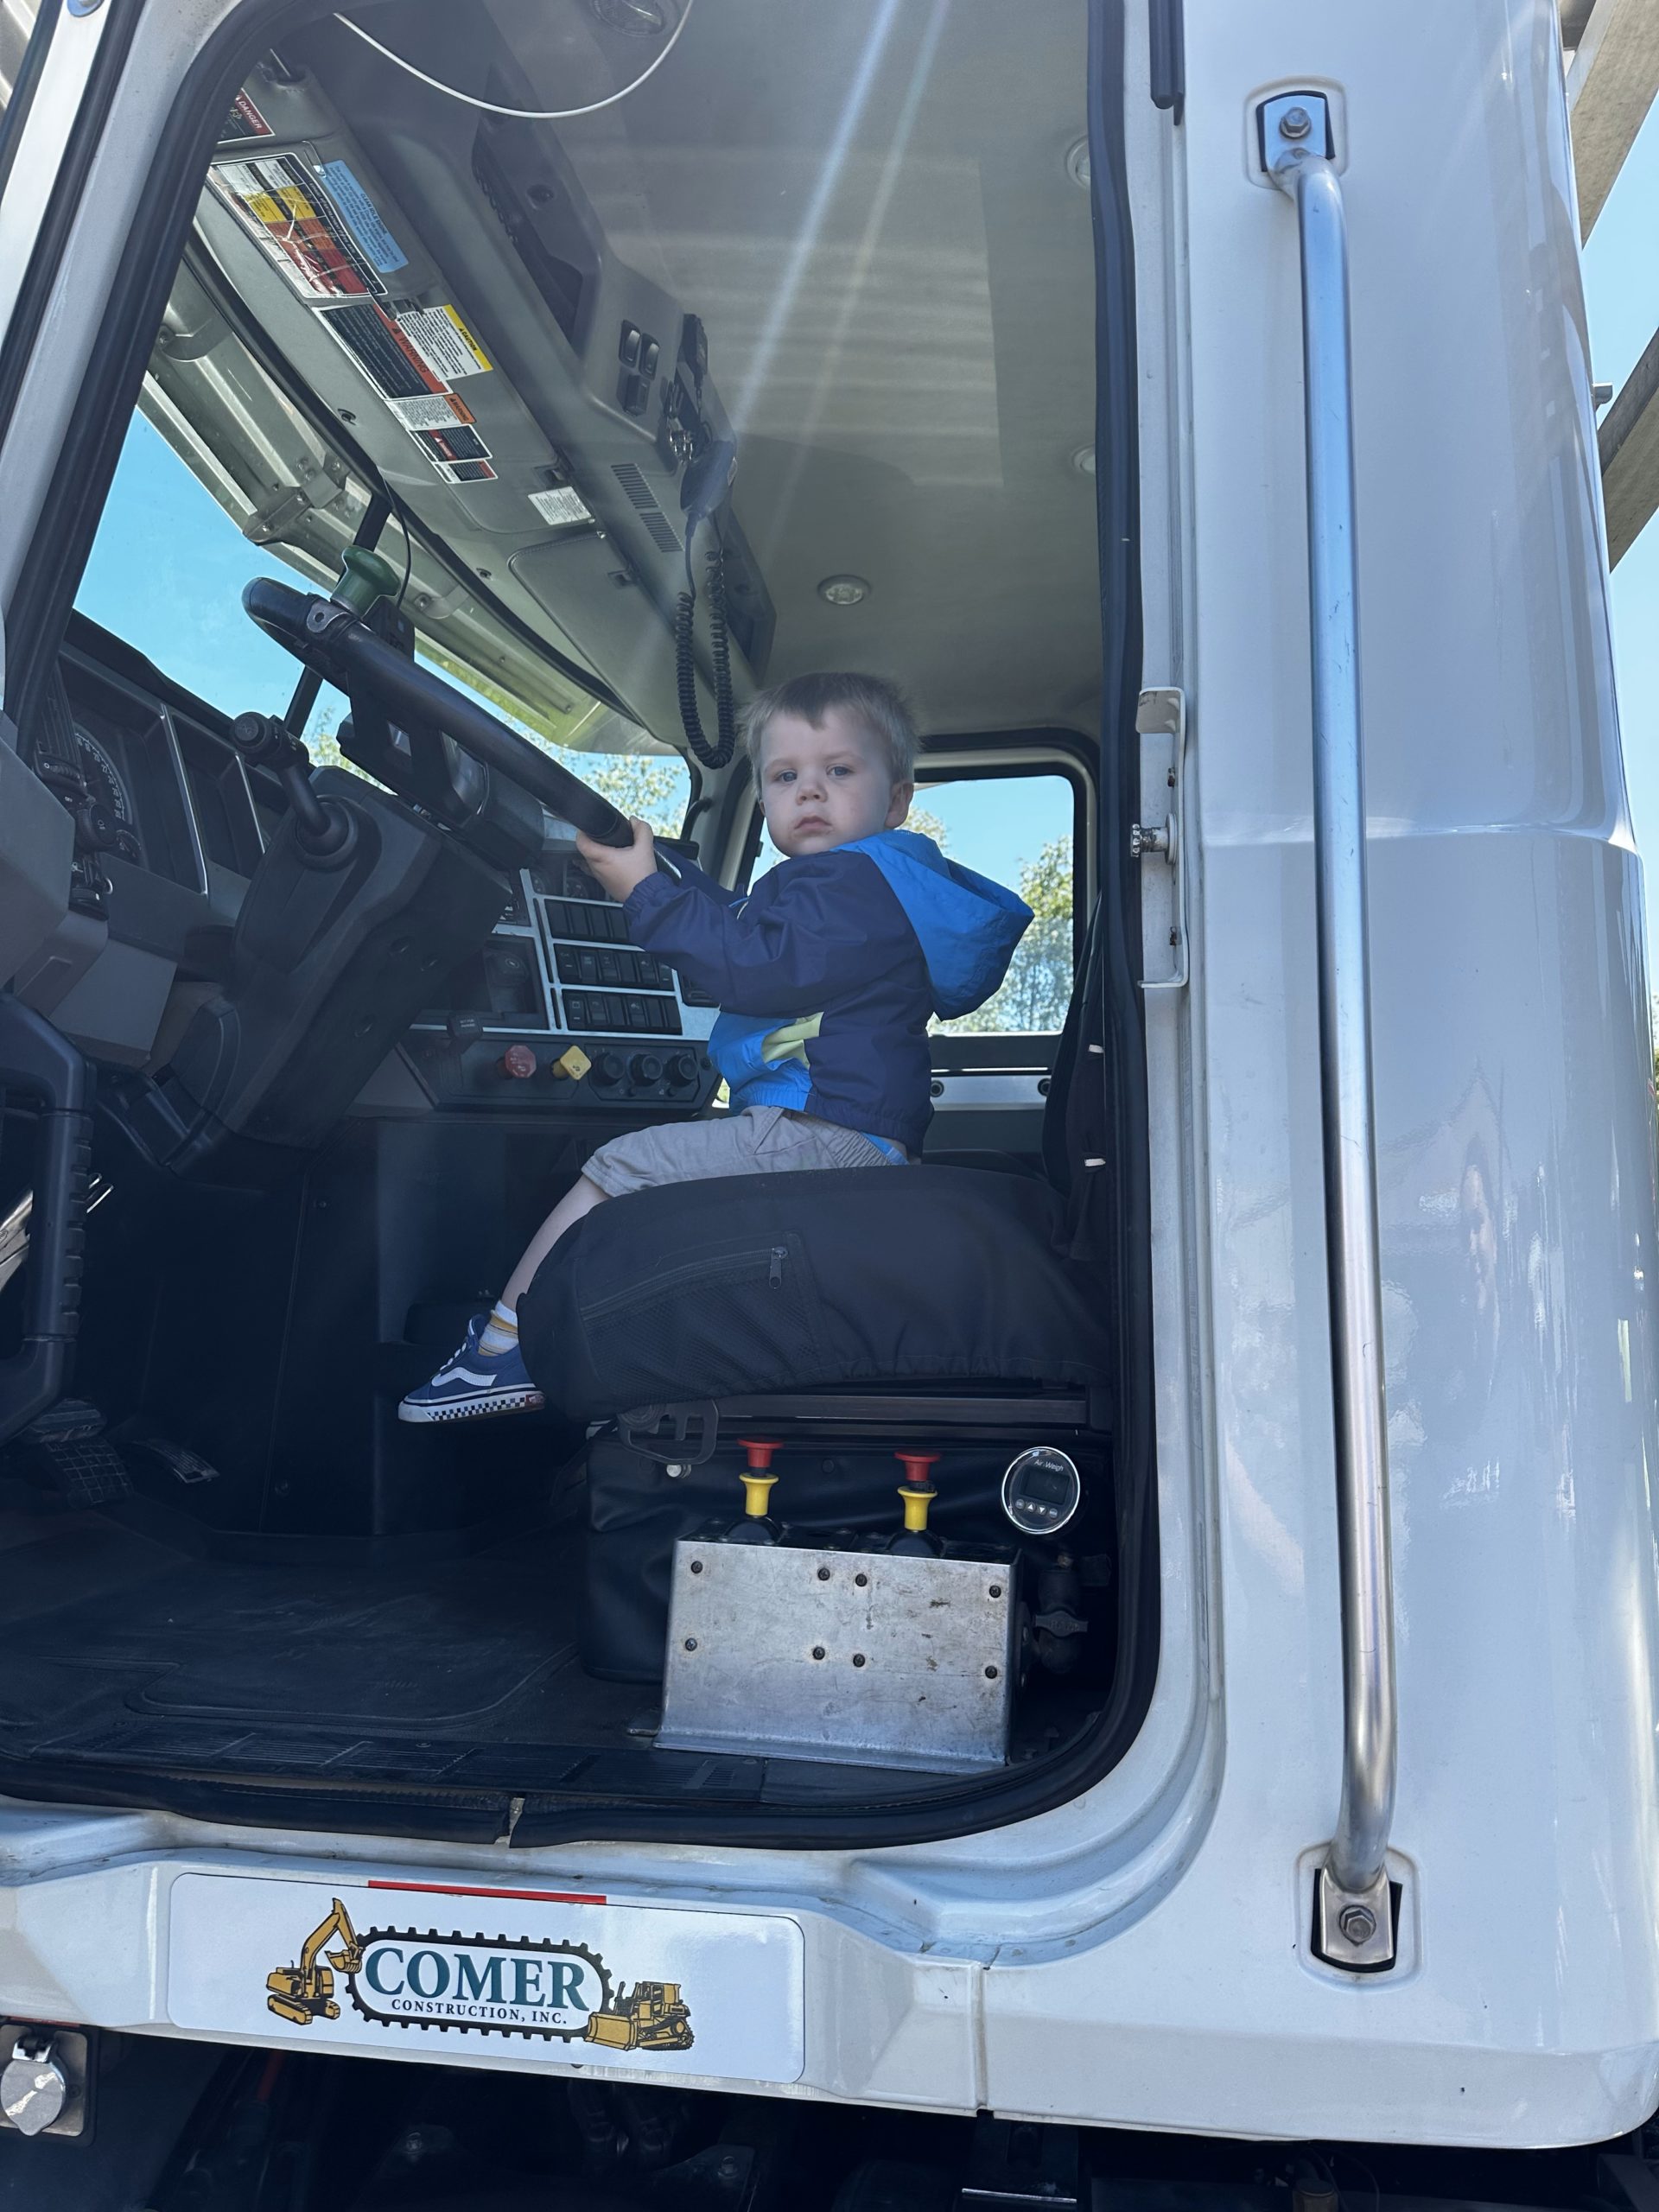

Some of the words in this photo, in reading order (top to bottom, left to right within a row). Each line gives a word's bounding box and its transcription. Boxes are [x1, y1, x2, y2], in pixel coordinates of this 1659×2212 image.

[238, 100, 263, 129] DANGER
[461, 330, 478, 351] CAUTION
[398, 338, 427, 373] WARNING
[365, 1948, 589, 2012] COMER
[391, 1999, 525, 2023] CONSTRUCTION,
[532, 2010, 567, 2024] INC.
